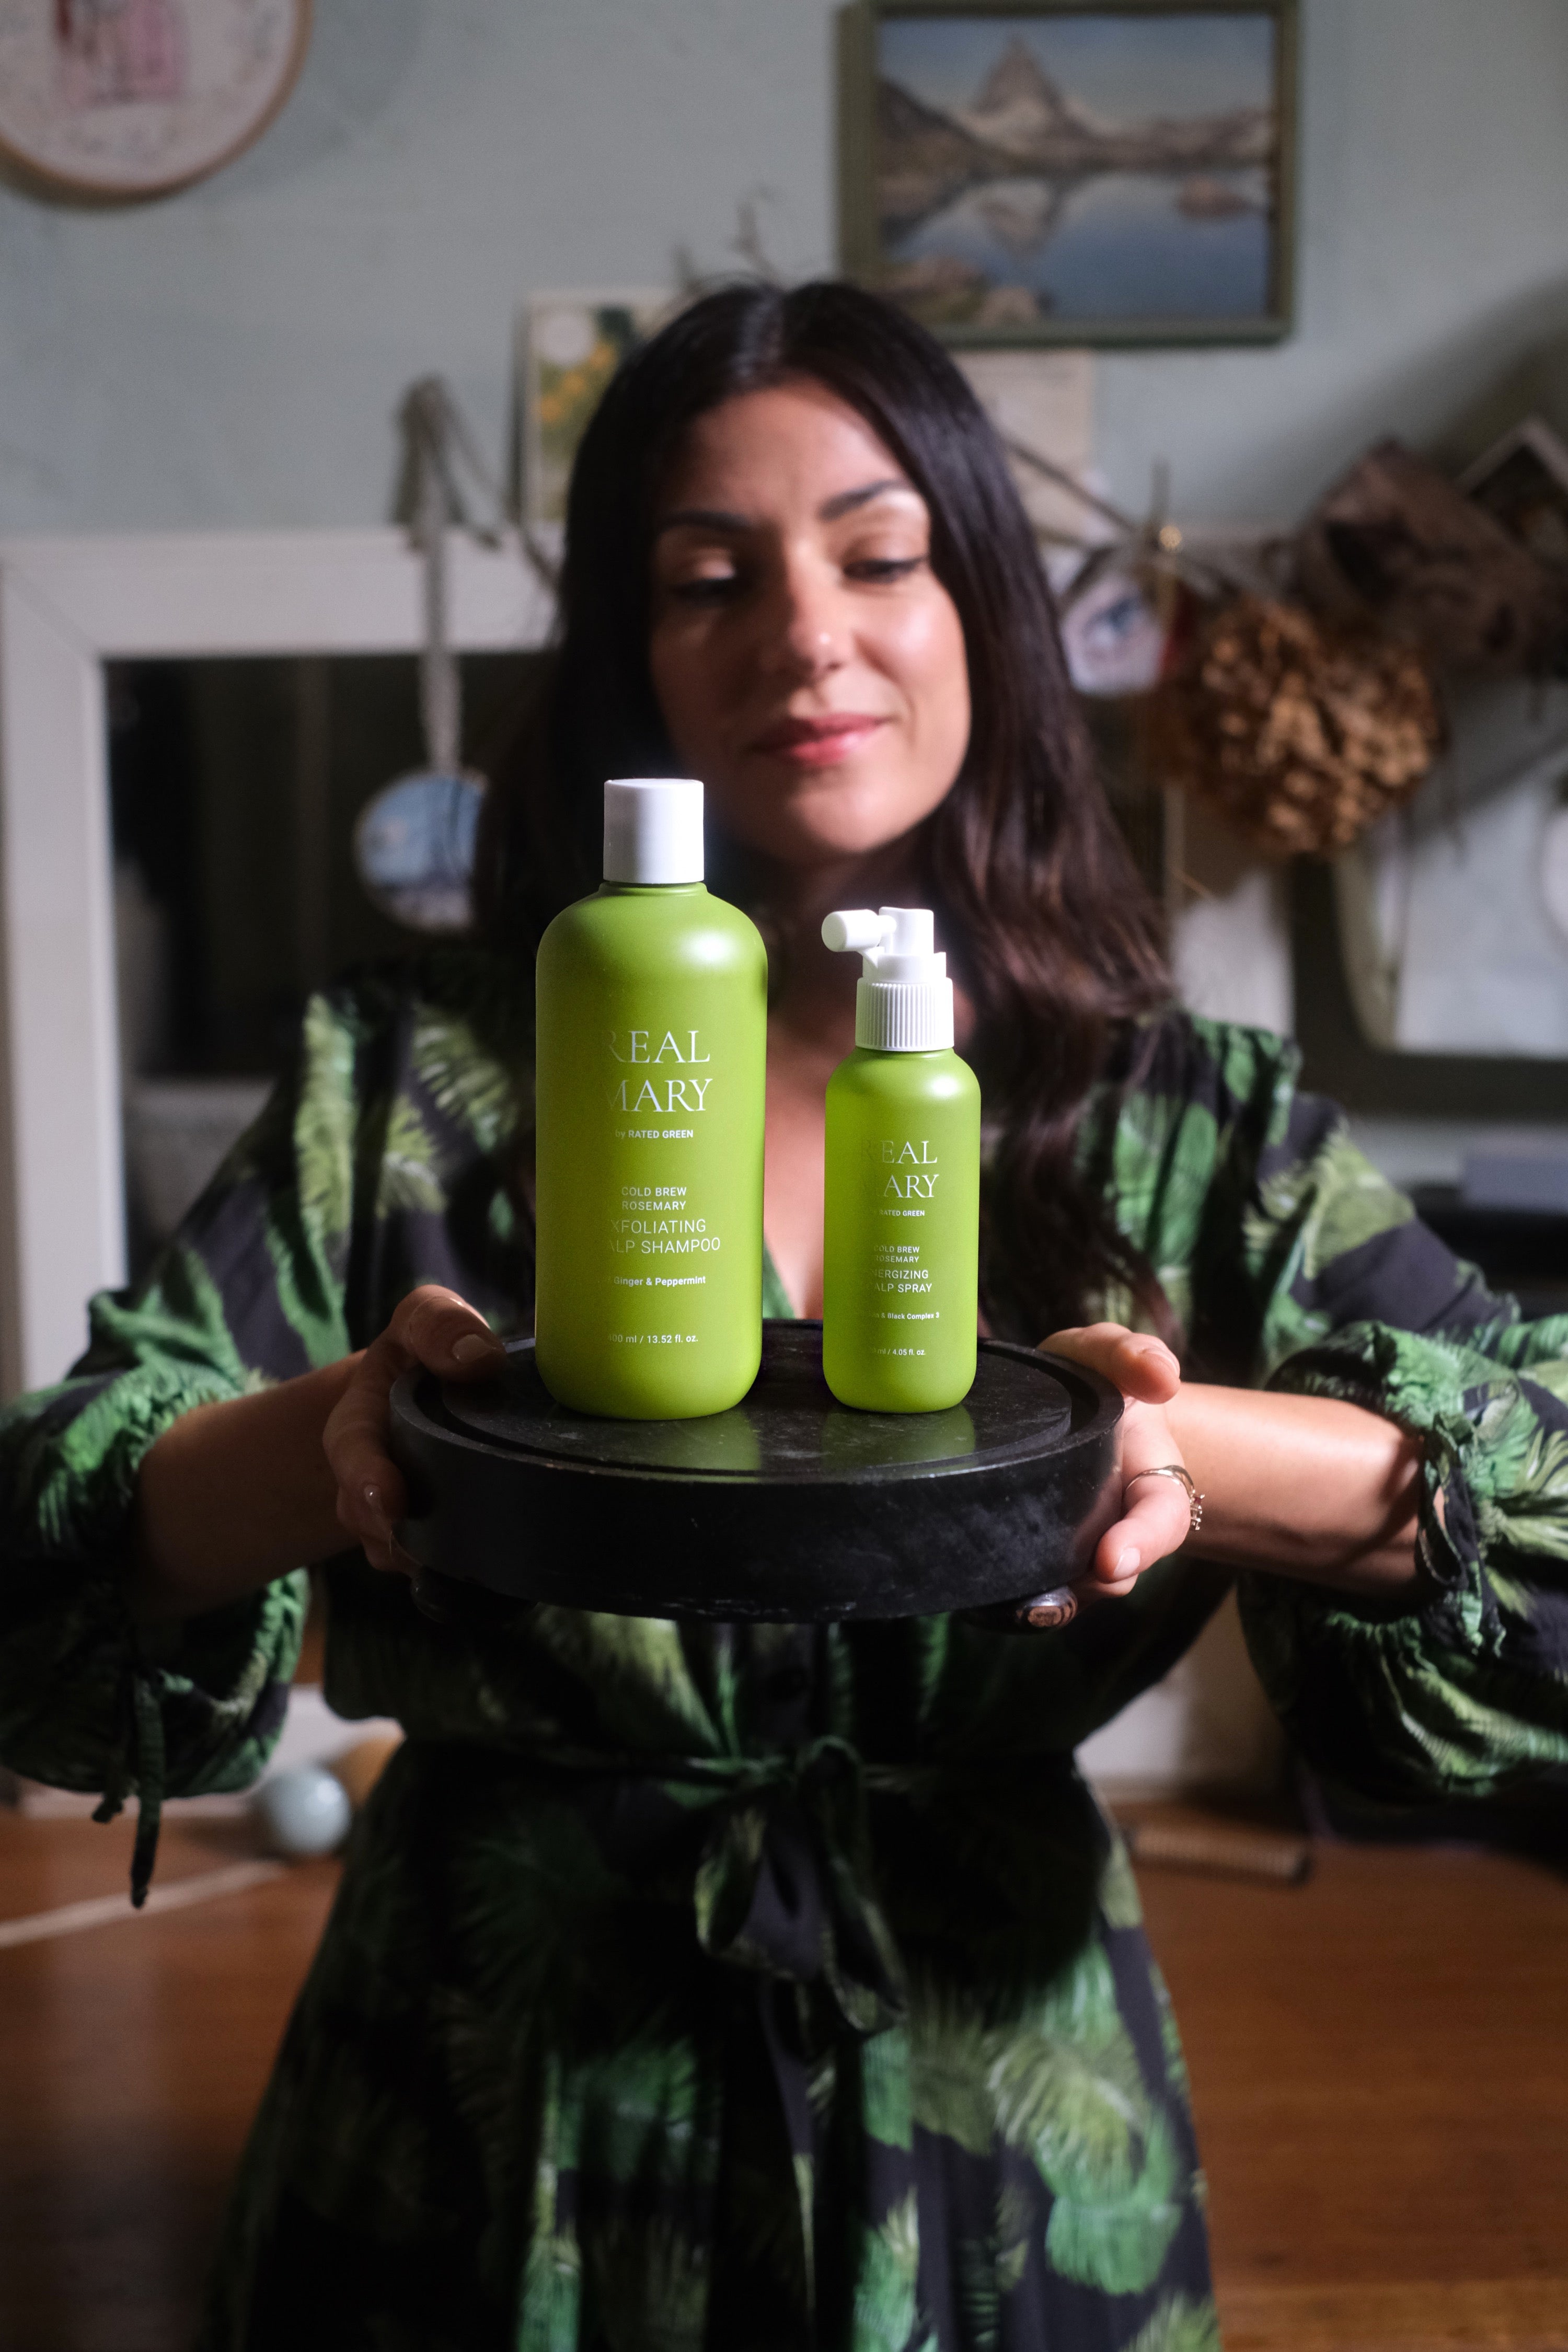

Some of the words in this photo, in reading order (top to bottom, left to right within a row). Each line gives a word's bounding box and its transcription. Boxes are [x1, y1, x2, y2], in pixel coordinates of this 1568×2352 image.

[615, 1129, 625, 1139] by
[628, 1129, 659, 1138] RATED
[662, 1129, 694, 1138] GREEN
[880, 1140, 938, 1164] EAL
[883, 1174, 939, 1198] ARY
[622, 1187, 651, 1196] COLD
[655, 1187, 687, 1196] BREW
[622, 1201, 686, 1210] ROSEMARY
[610, 1219, 706, 1233] XFOLIATING
[641, 1237, 720, 1253] SHAMPOO
[614, 1277, 643, 1287] Ginger
[646, 1277, 652, 1286] &
[655, 1276, 706, 1287] Peppermint
[897, 1283, 932, 1293] SPRAY
[639, 1335, 643, 1344] /
[675, 1334, 683, 1343] fl.
